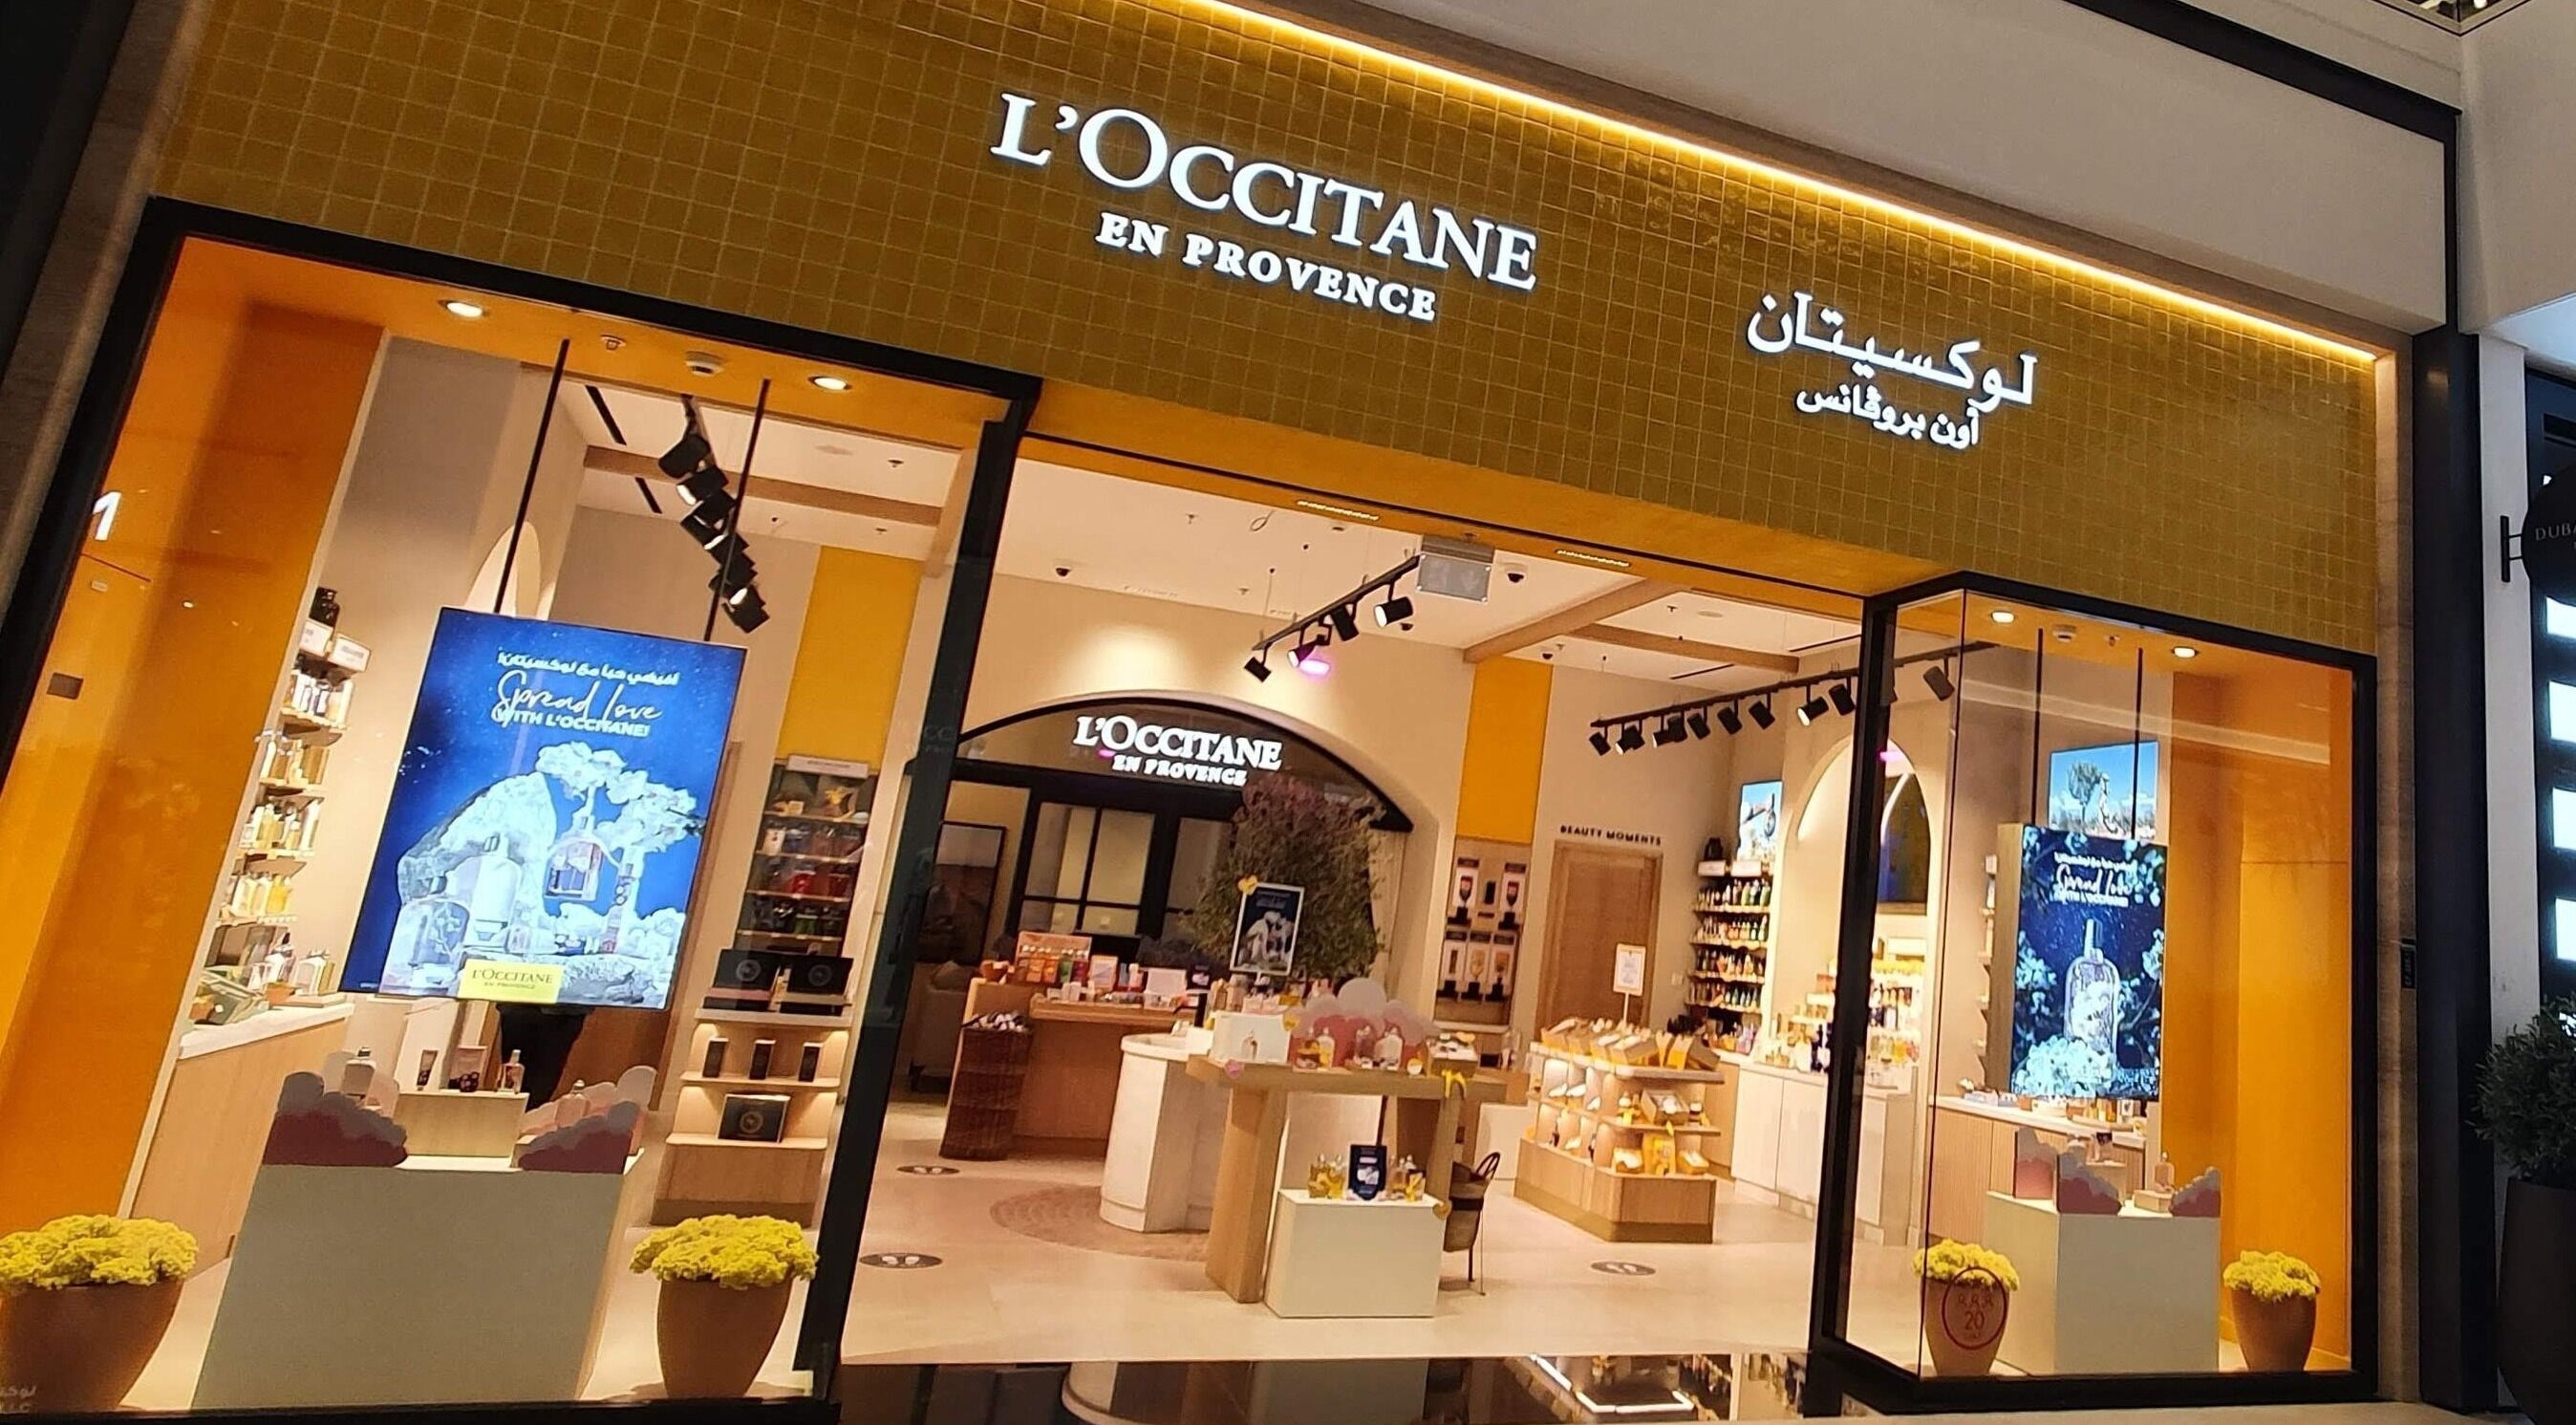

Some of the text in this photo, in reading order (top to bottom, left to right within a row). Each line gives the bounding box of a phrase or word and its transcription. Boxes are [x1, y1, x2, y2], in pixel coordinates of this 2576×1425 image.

[990, 93, 1537, 291] L'OCCITANE
[1095, 212, 1437, 321] EN PROVENCE
[1748, 291, 2038, 414] لوكسيتان
[491, 669, 663, 728] Spread love
[1073, 715, 1283, 771] L'OCCITANE
[1112, 754, 1248, 787] EN PROVENCE
[1559, 825, 1662, 847] BEAUTY MOMENTS
[472, 968, 554, 984] L'OCCITANE
